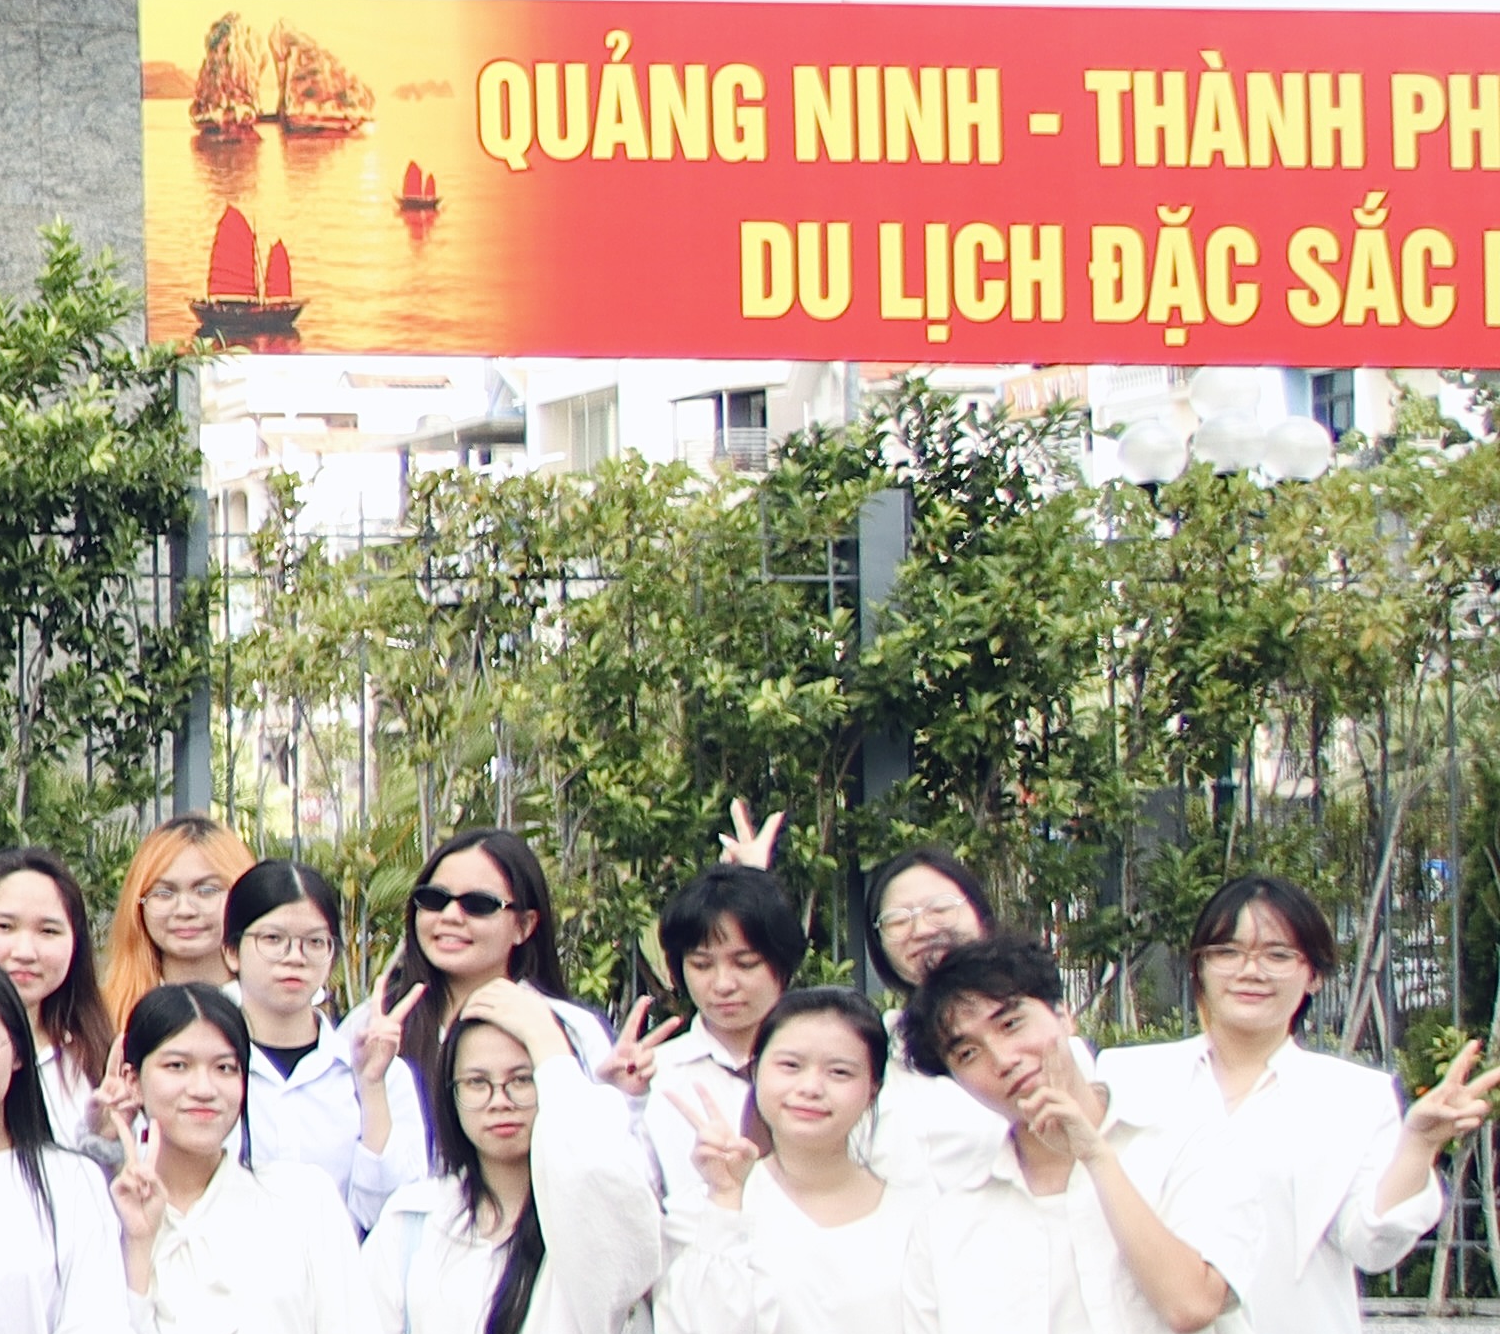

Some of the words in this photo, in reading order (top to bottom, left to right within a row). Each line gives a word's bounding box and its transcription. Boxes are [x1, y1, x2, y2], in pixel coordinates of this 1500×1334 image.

[477, 29, 768, 170] QUẢNG
[793, 65, 1002, 164] NINH
[1085, 49, 1366, 168] THÀNH
[1389, 71, 1500, 171] PH
[739, 220, 854, 320] DU
[879, 223, 1064, 342] LỊCH
[1088, 205, 1260, 346] ĐẶC
[1286, 190, 1458, 329] SẮC
